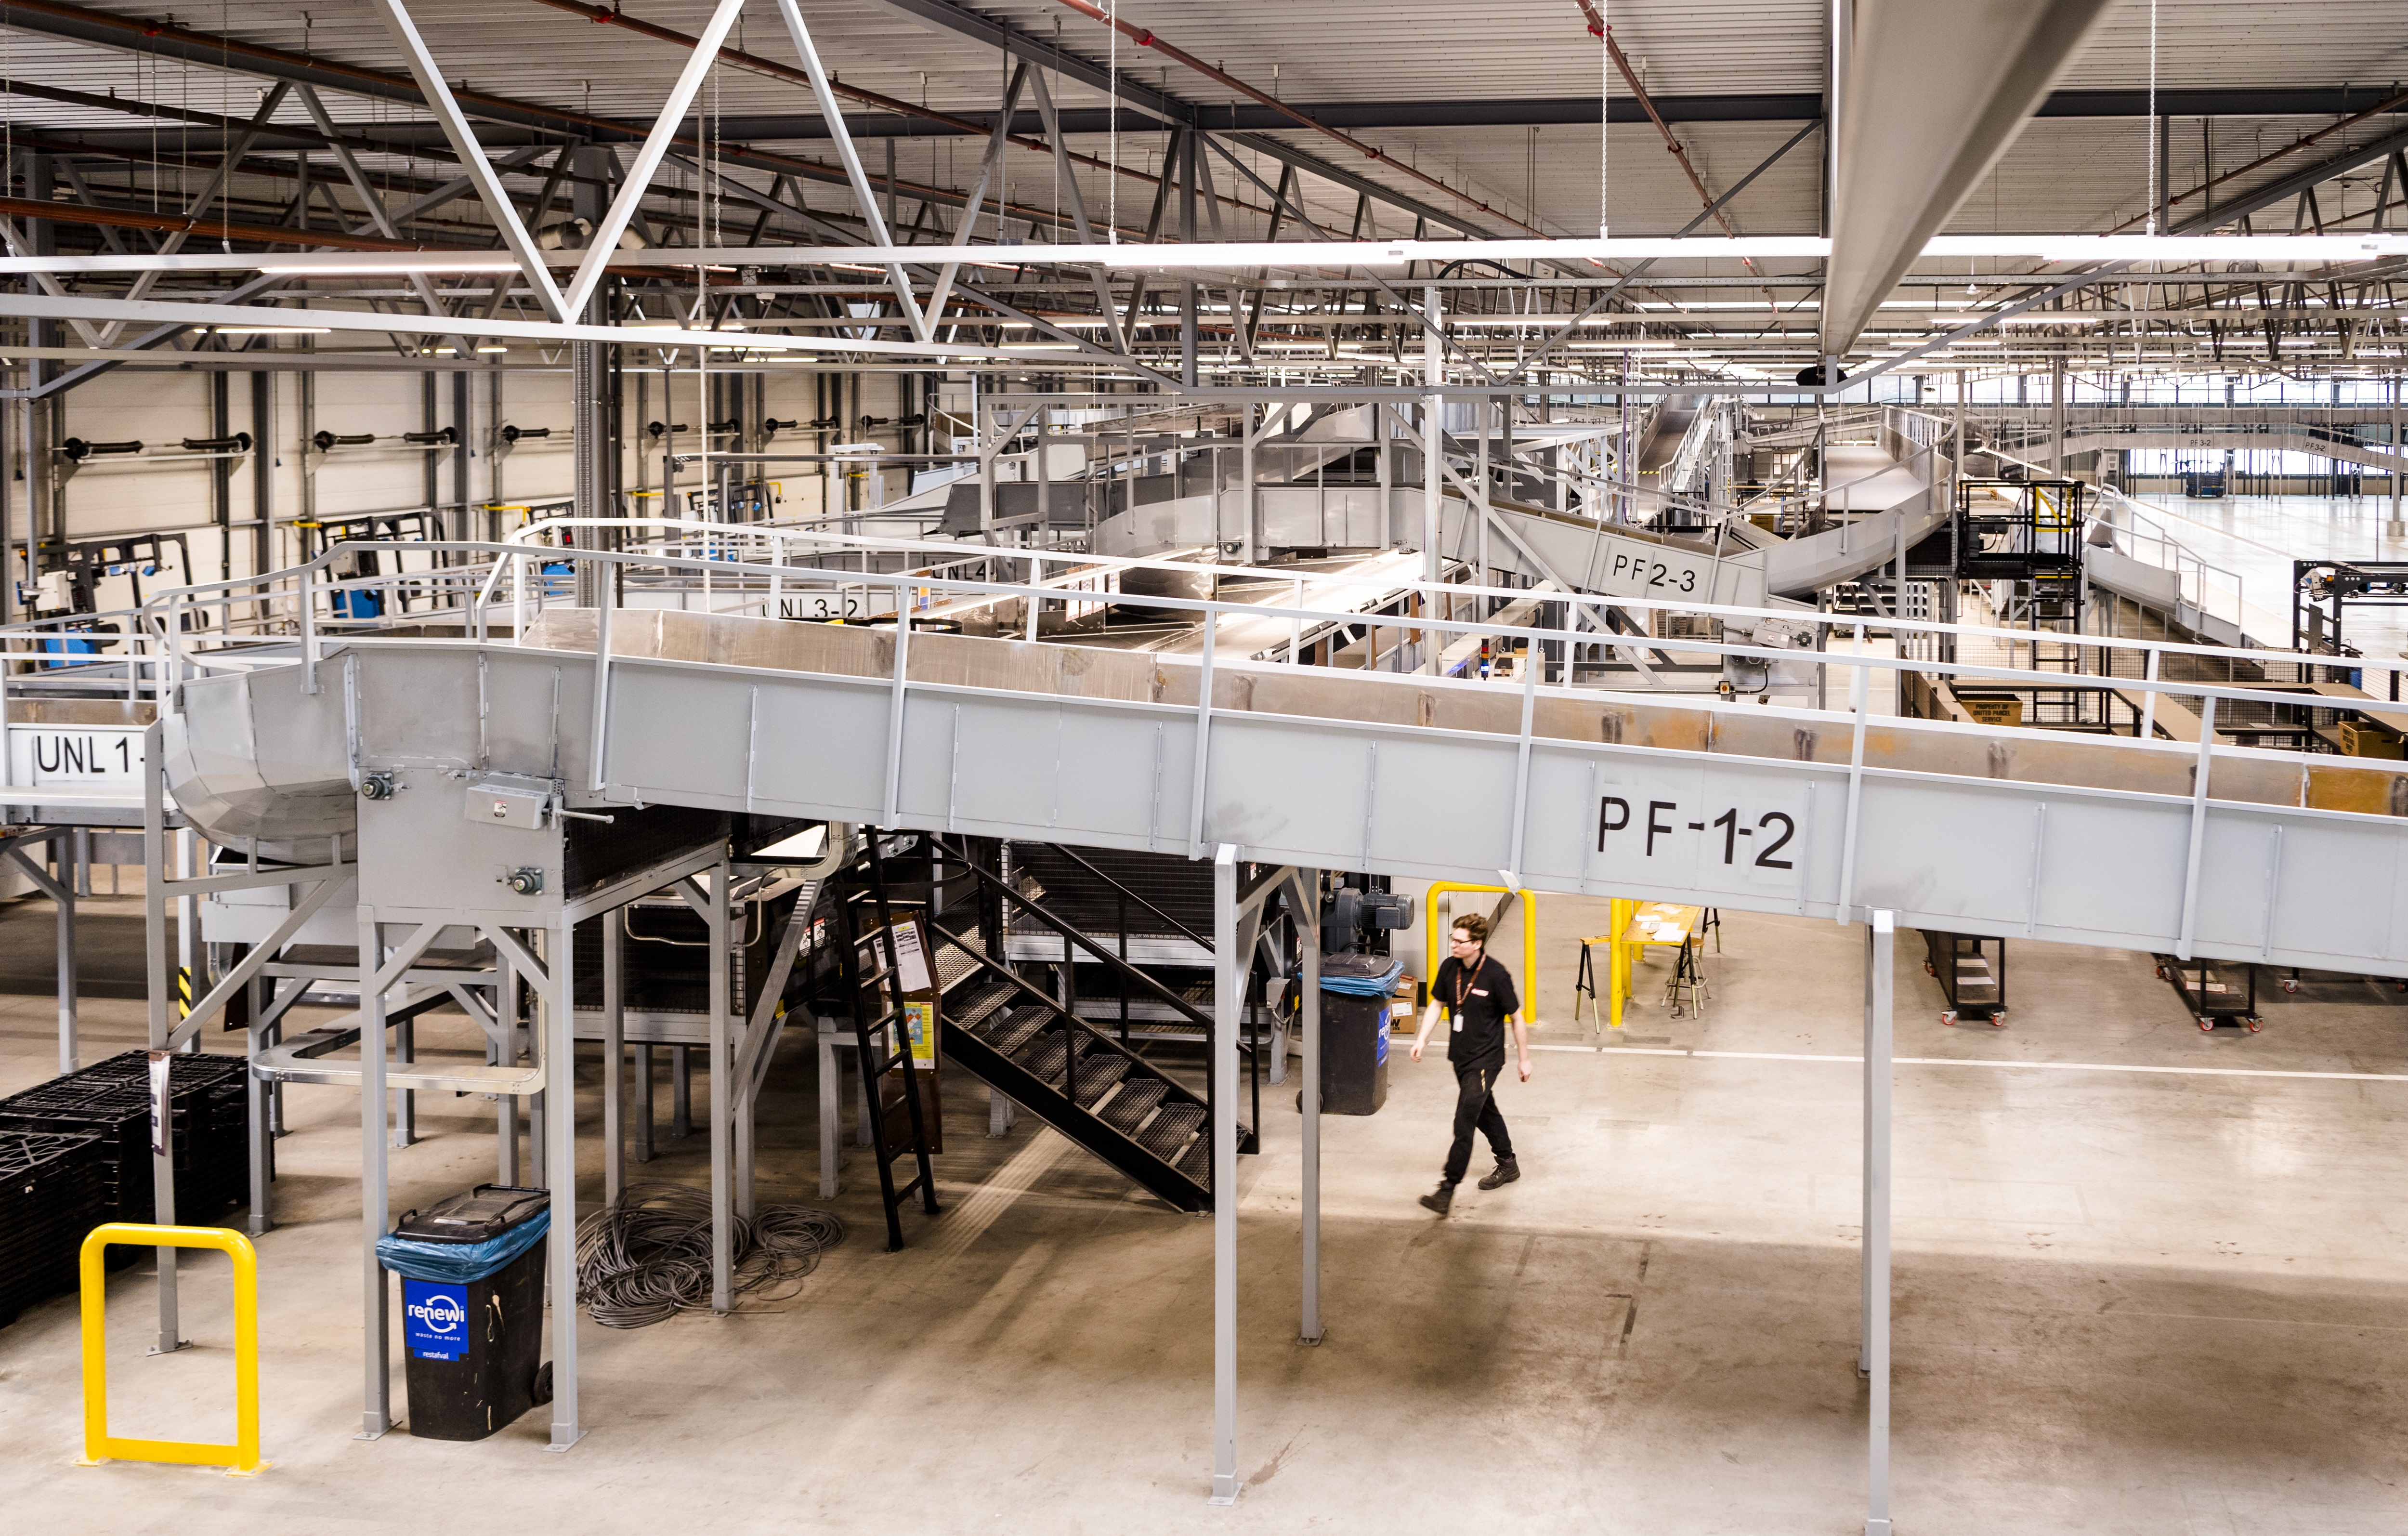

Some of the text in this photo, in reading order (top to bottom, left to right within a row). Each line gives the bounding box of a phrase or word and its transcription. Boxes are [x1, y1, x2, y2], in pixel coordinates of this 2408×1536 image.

[1613, 554, 1695, 592] PF 2-3
[37, 735, 105, 773] UNL
[408, 1301, 465, 1326] renewi
[422, 1352, 449, 1360] restafval
